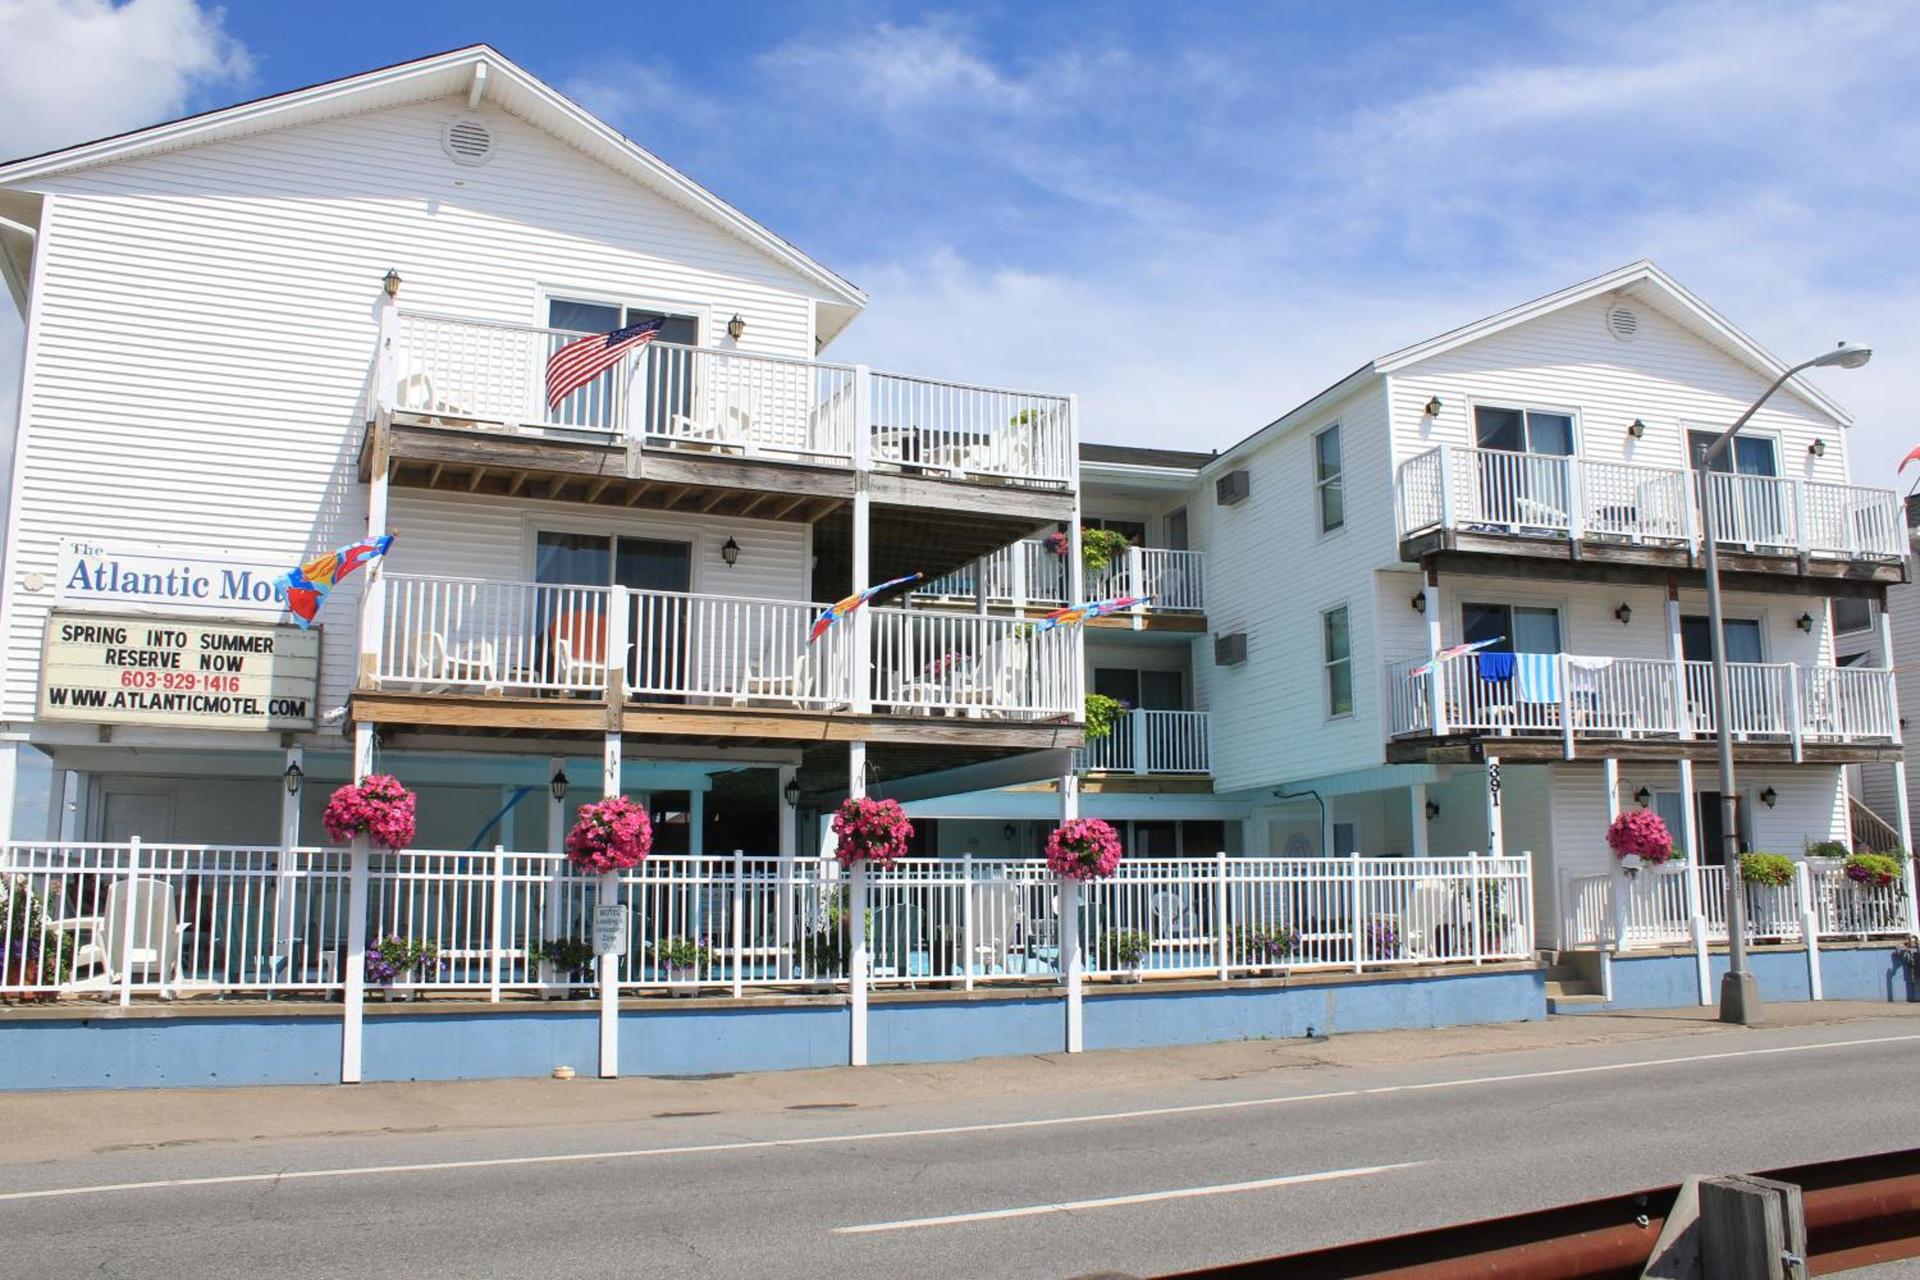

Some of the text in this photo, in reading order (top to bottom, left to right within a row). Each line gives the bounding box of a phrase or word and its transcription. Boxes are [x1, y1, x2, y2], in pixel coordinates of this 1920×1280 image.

[71, 543, 104, 556] The
[66, 558, 210, 599] Atlantic
[62, 624, 274, 654] SPRING INTO SUMMER
[105, 648, 244, 673] RESERVE NOW
[120, 670, 240, 693] 603-929-1416
[1489, 763, 1500, 807] 391
